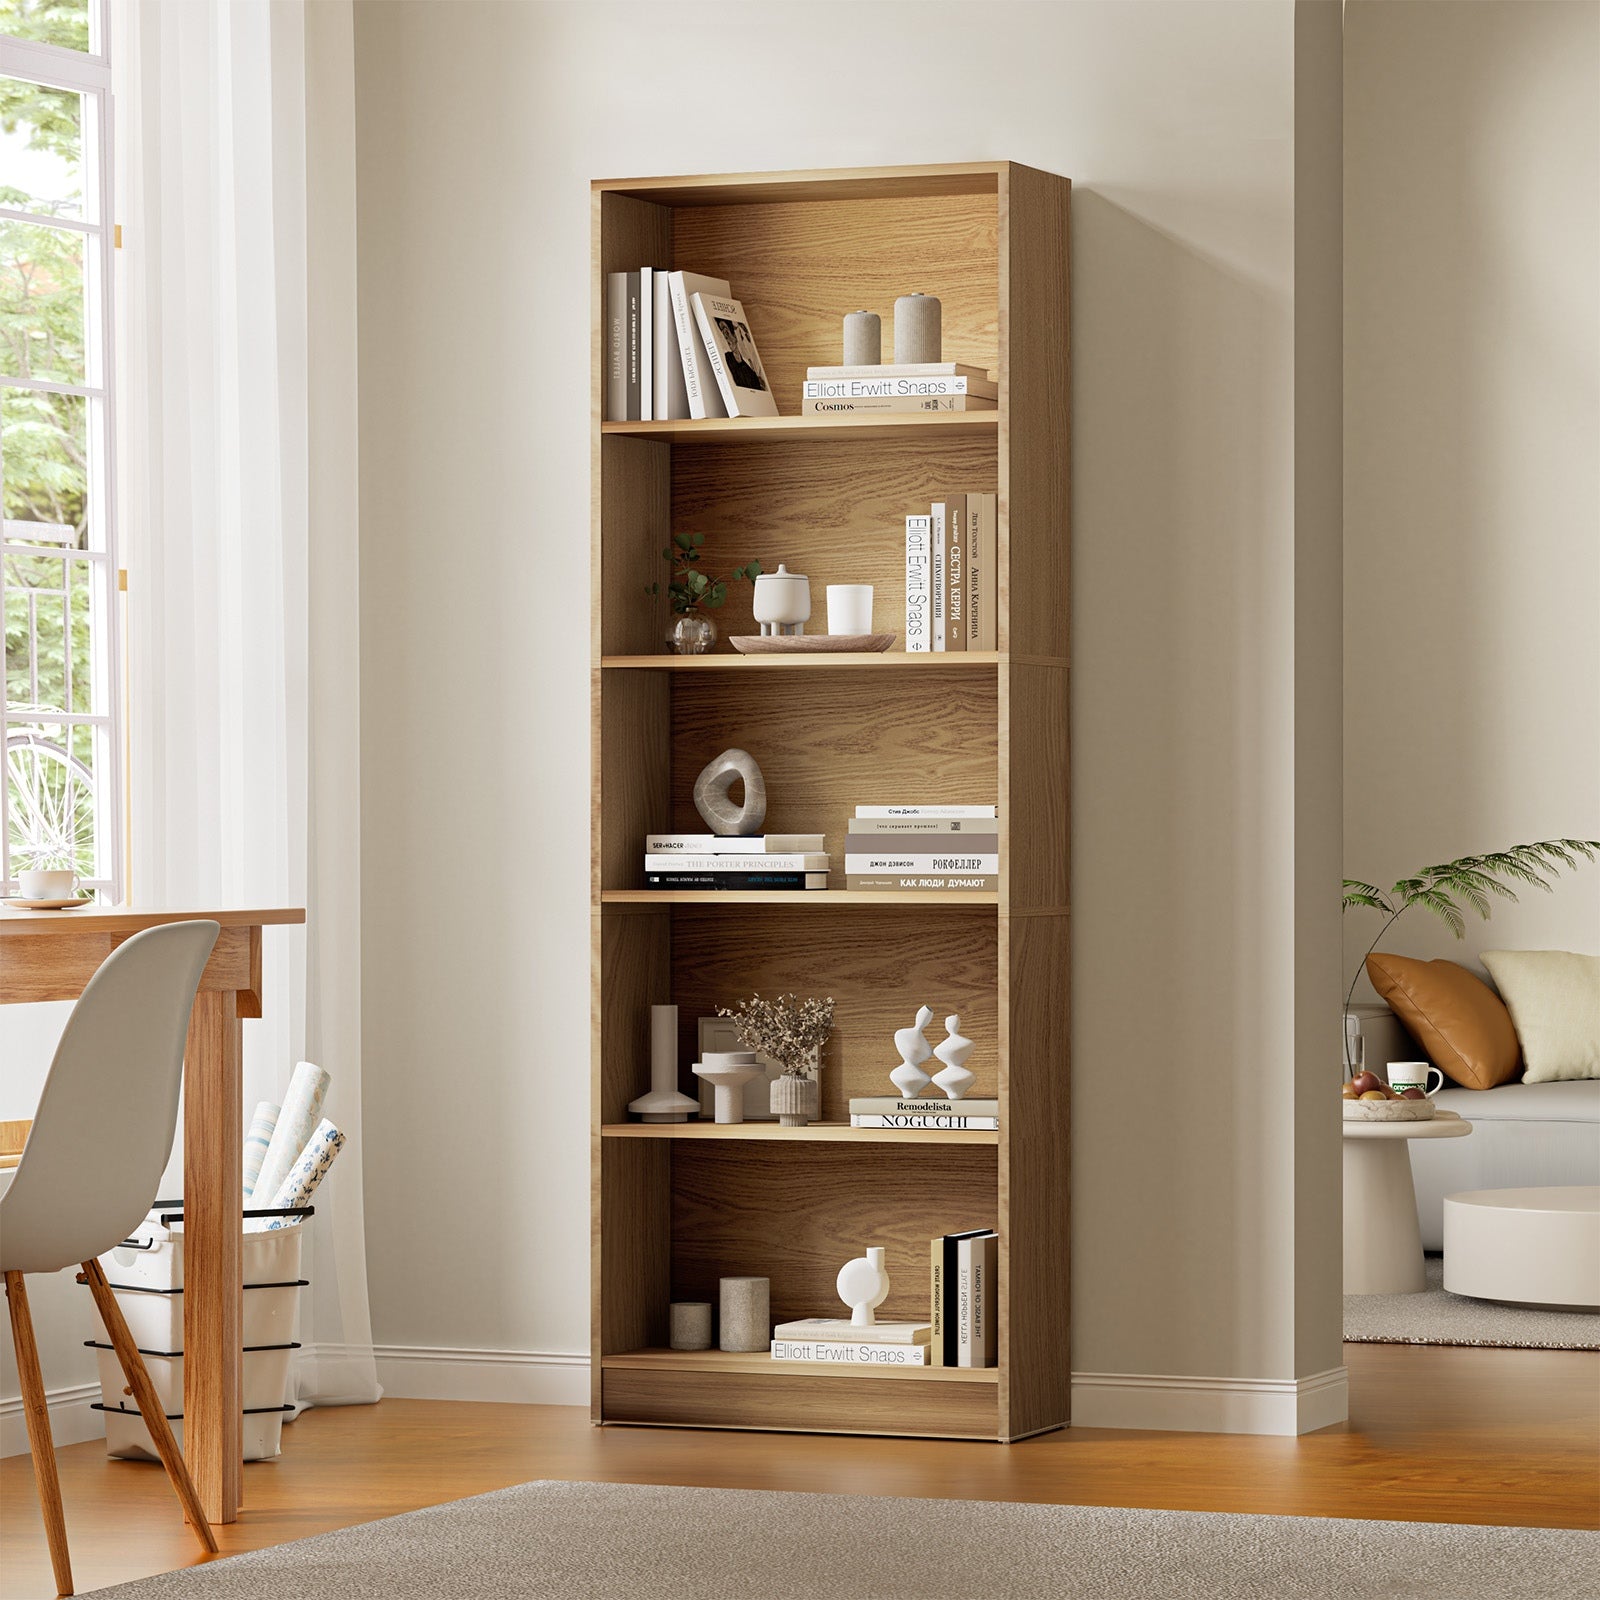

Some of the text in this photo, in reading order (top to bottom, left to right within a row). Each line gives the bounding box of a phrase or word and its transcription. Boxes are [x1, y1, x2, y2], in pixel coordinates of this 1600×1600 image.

[807, 380, 947, 398] Elliott Erwitt Snaps
[815, 401, 854, 412] Cosmos
[906, 518, 927, 636] Elliott Erwitt Snaps
[950, 546, 960, 621] СЕСТРА КЕРРИ
[933, 859, 982, 870] РОКФЕЛЛЕР
[900, 879, 916, 887] КАК
[918, 879, 945, 888] ЛЮДИ
[947, 879, 985, 888] ДУМАЮТ
[897, 1102, 952, 1111] Remodelista
[882, 1115, 968, 1128] NOGUCHI
[774, 1343, 905, 1364] Elliott Erwitt Snaps
